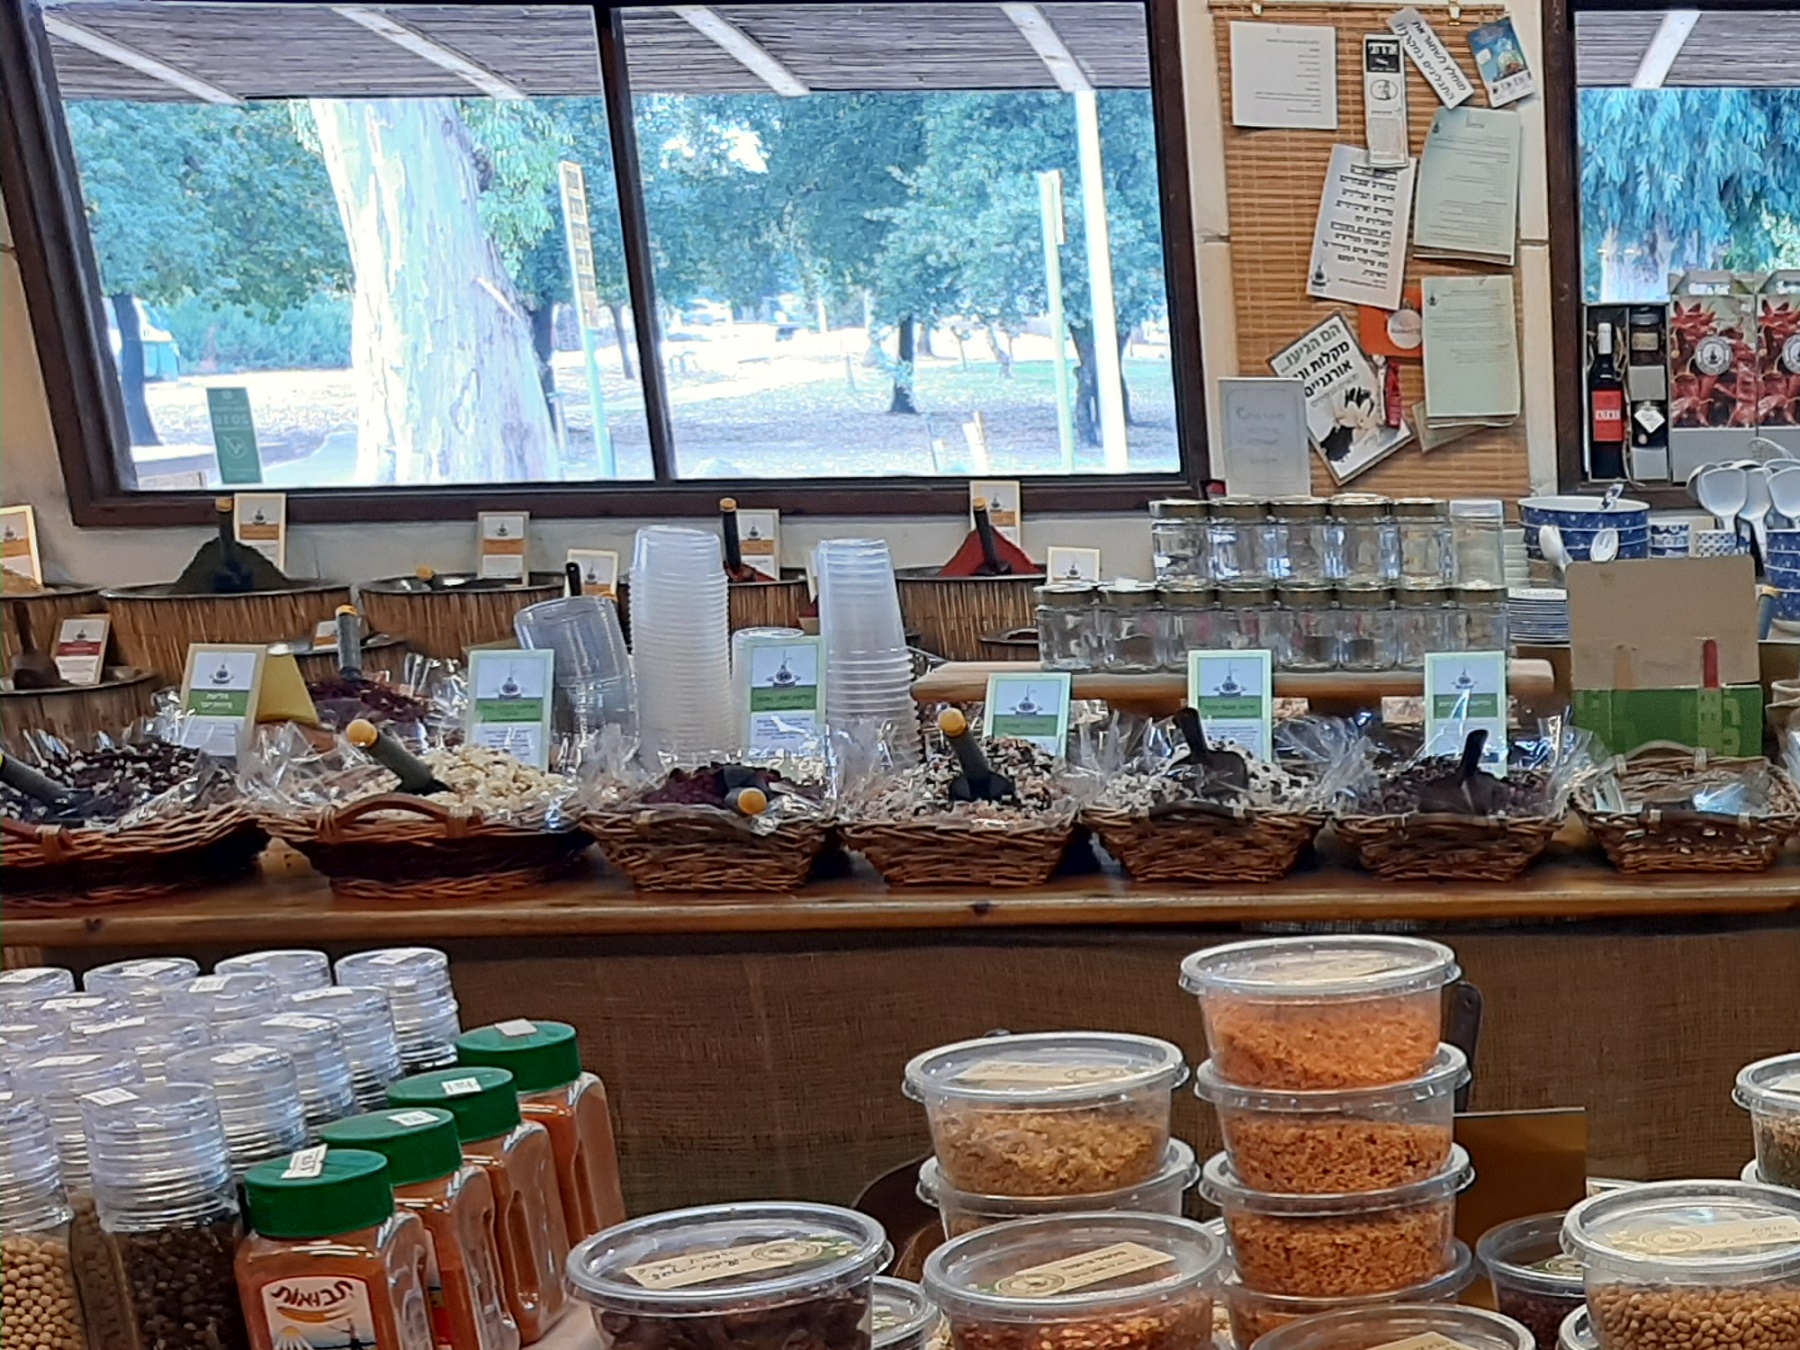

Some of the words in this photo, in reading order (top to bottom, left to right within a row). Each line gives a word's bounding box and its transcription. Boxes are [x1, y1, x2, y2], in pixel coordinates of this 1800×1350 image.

[1412, 21, 1425, 34] את
[1423, 60, 1455, 100] התבלינים
[1444, 65, 1467, 92] מומלץ
[1320, 324, 1342, 342] הם
[1310, 341, 1350, 374] מקלות
[1304, 358, 1353, 397] אורגניים
[271, 1280, 353, 1307] תבואות
